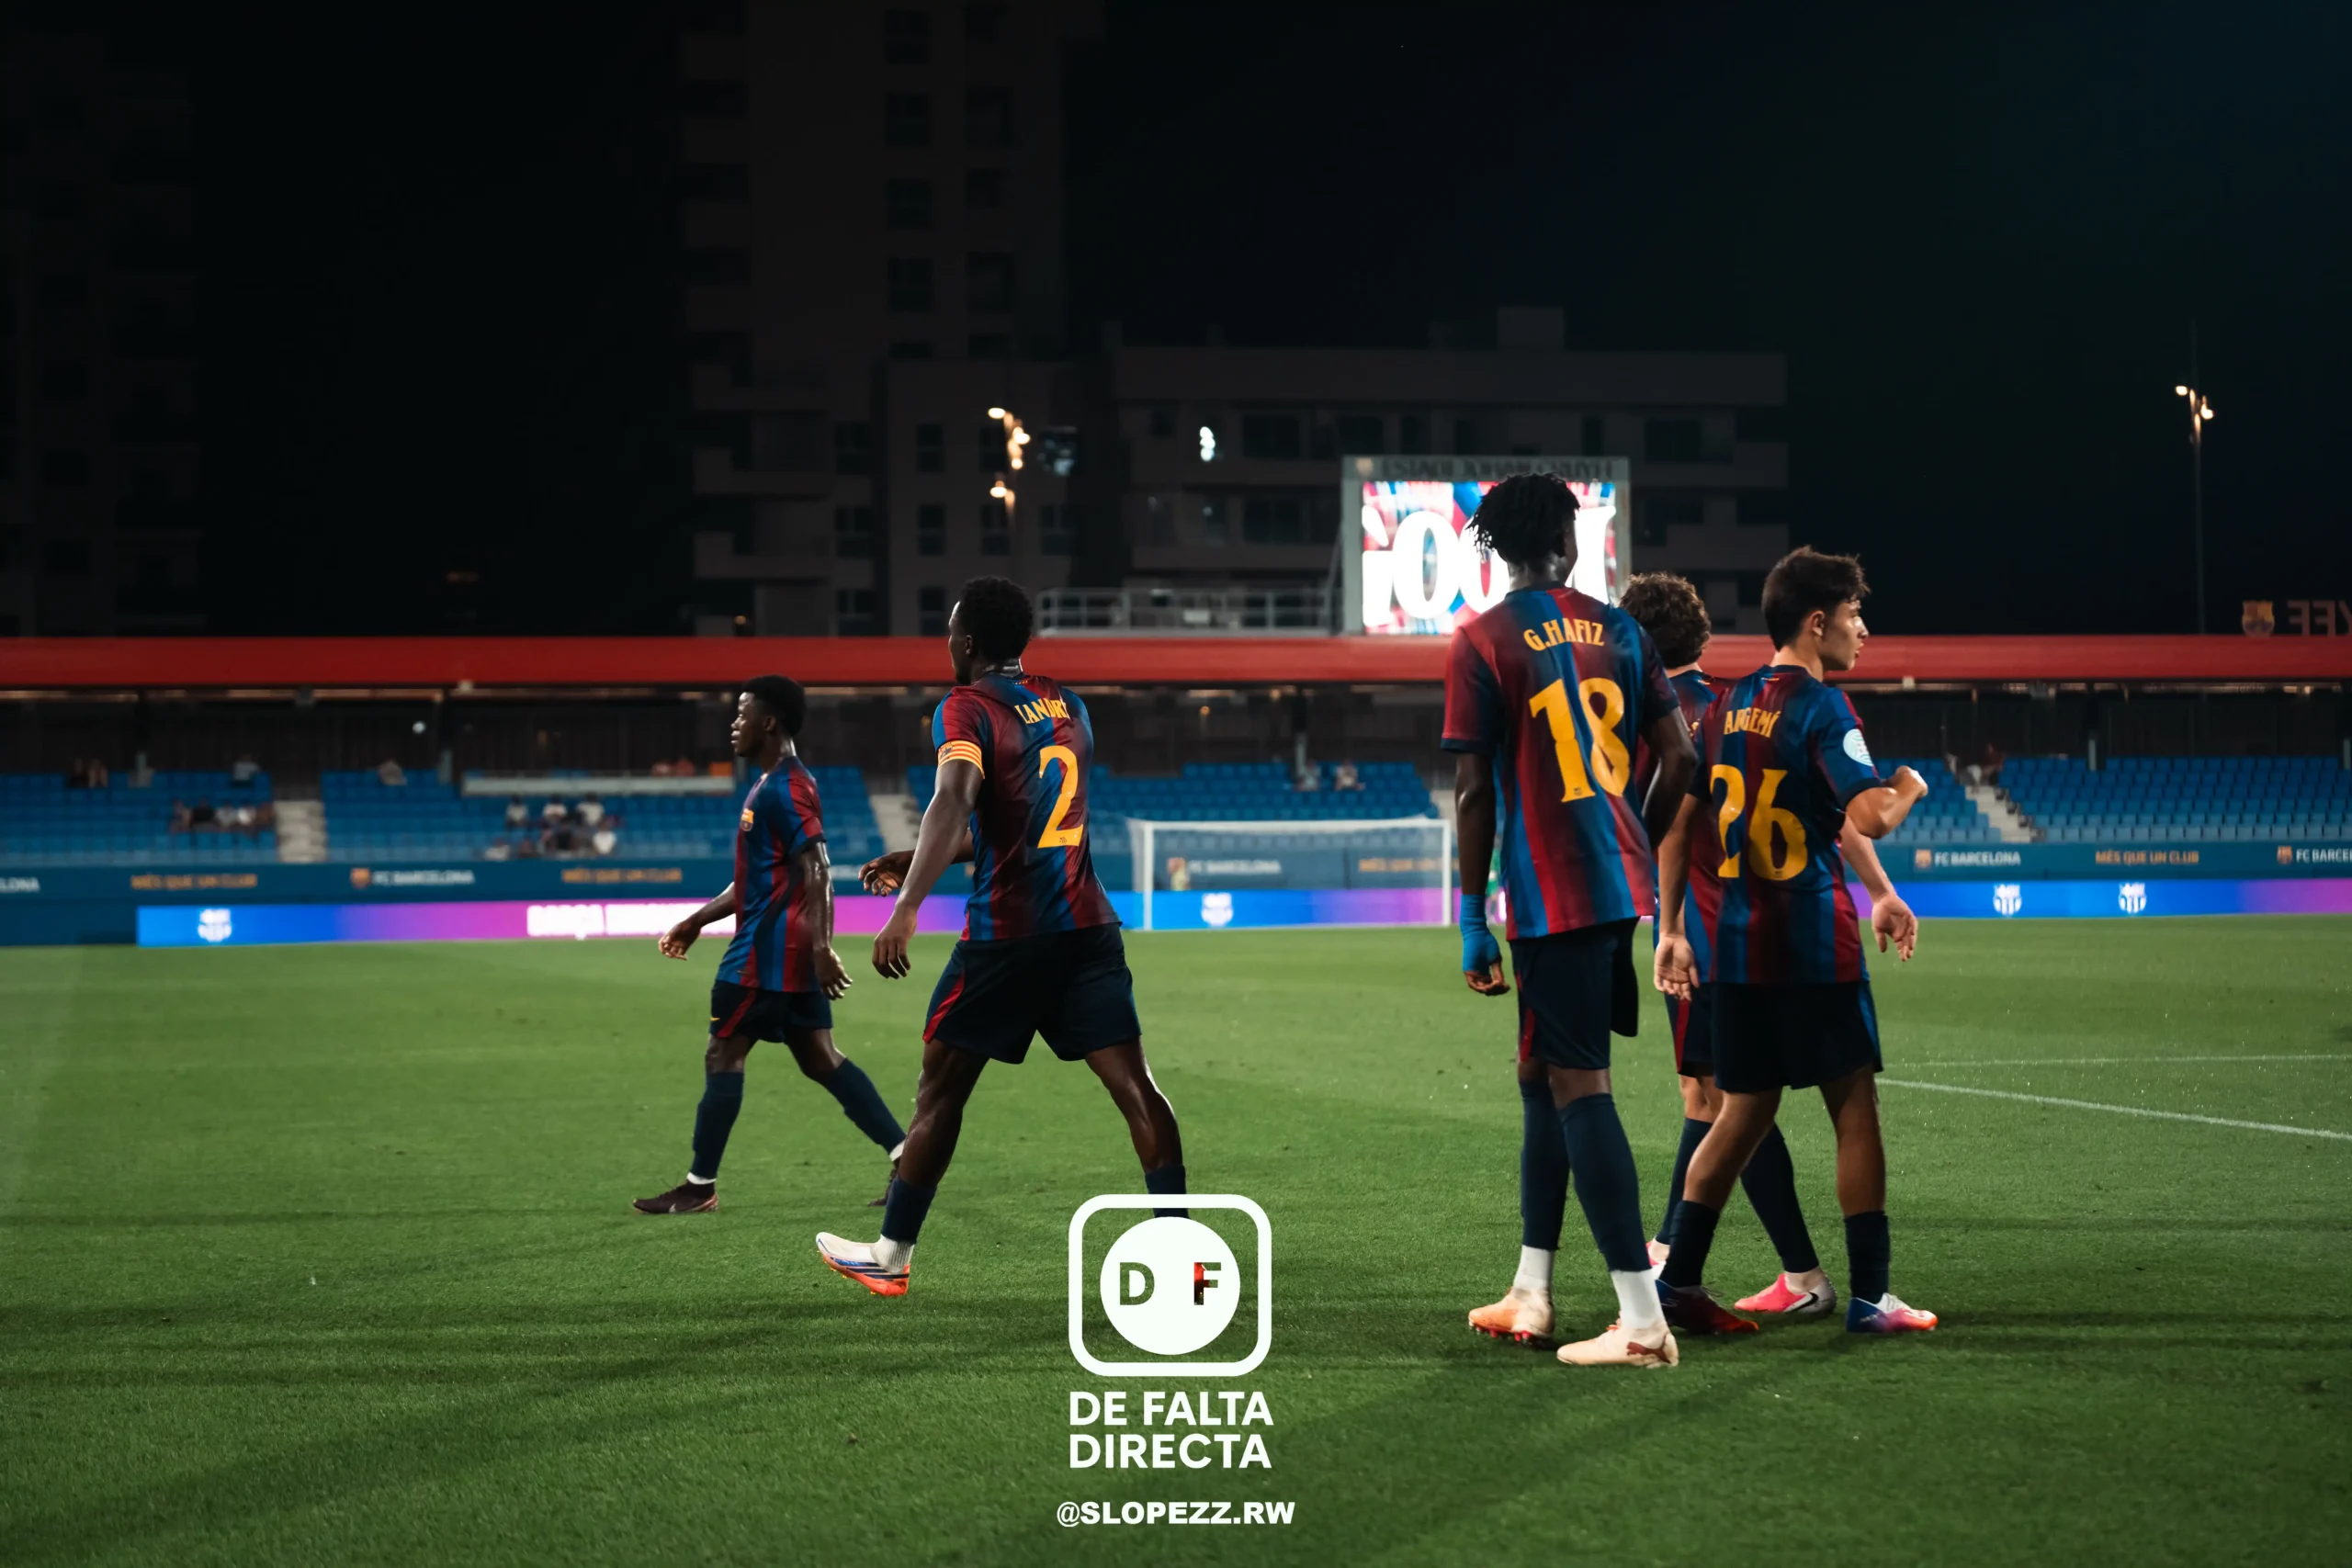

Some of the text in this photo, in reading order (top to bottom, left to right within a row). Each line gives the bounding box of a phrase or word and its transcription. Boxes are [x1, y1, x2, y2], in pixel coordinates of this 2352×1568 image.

[1523, 617, 1605, 651] G.HAFIZ
[1529, 678, 1630, 802] 18
[1036, 745, 1084, 849] 2
[1711, 764, 1808, 880] 26
